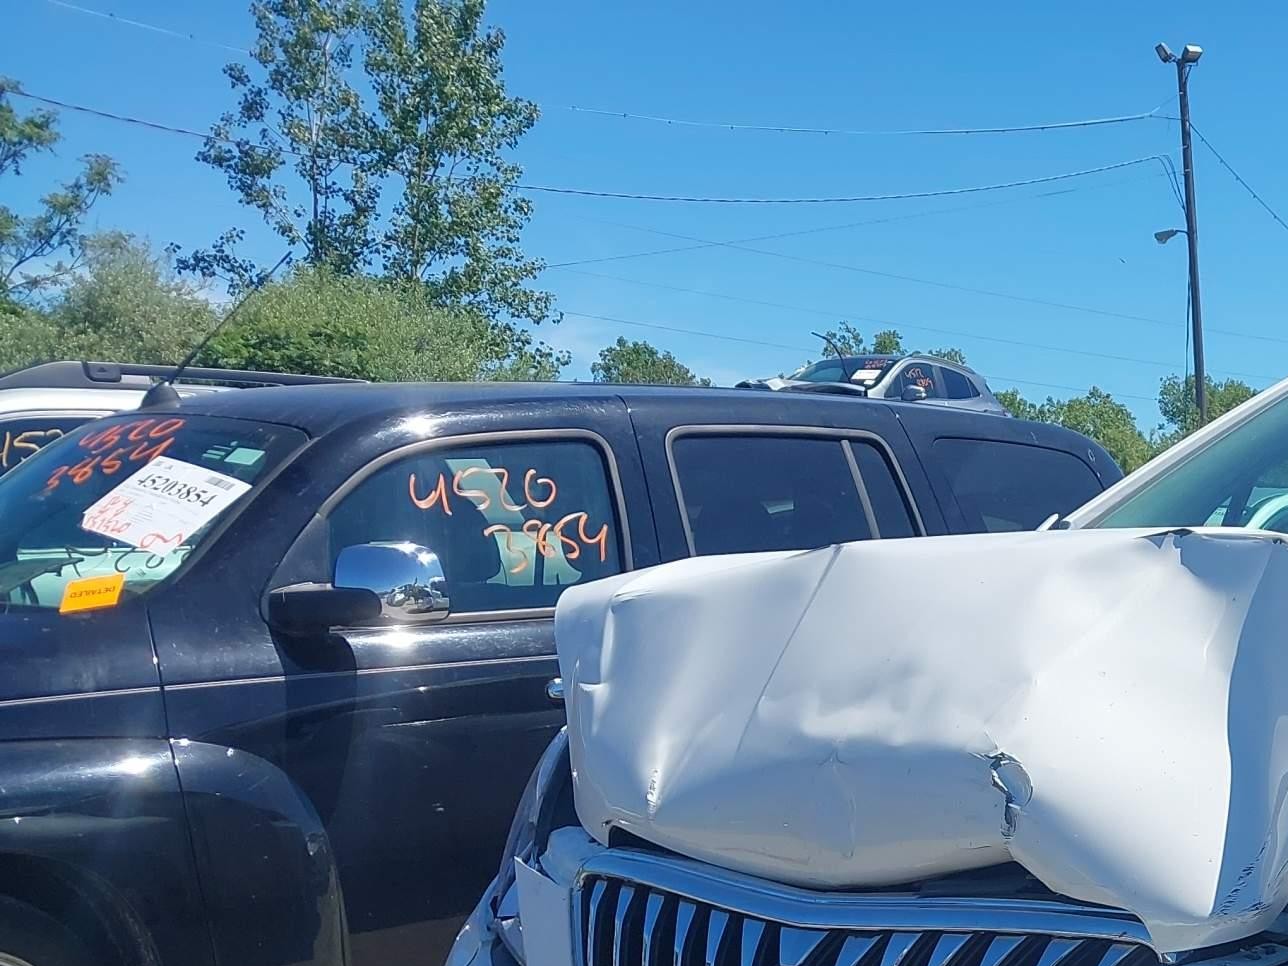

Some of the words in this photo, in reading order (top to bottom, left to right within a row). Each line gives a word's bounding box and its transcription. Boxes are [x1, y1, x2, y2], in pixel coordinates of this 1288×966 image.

[136, 473, 218, 508] 45203854
[409, 467, 557, 516] 4520
[483, 511, 609, 574] 3854
[69, 586, 117, 599] DETAILED
